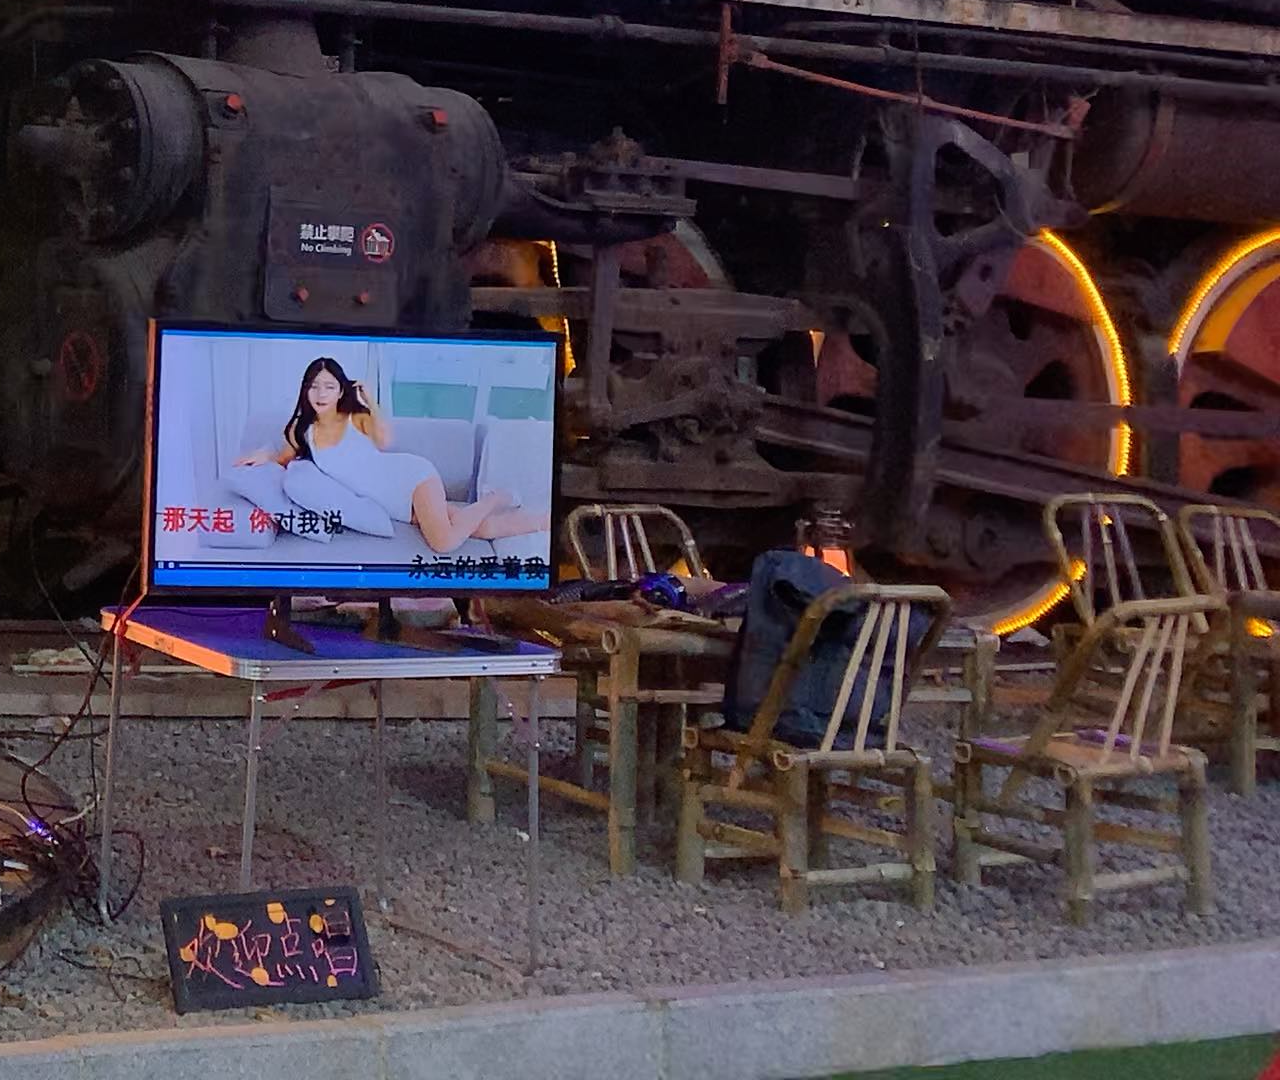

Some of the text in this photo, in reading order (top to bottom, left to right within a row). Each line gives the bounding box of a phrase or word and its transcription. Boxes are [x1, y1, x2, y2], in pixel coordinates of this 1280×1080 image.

[299, 223, 355, 243] 禁止攀爬
[300, 242, 353, 257] No Climbing
[162, 506, 345, 536] 那天起 你对我说
